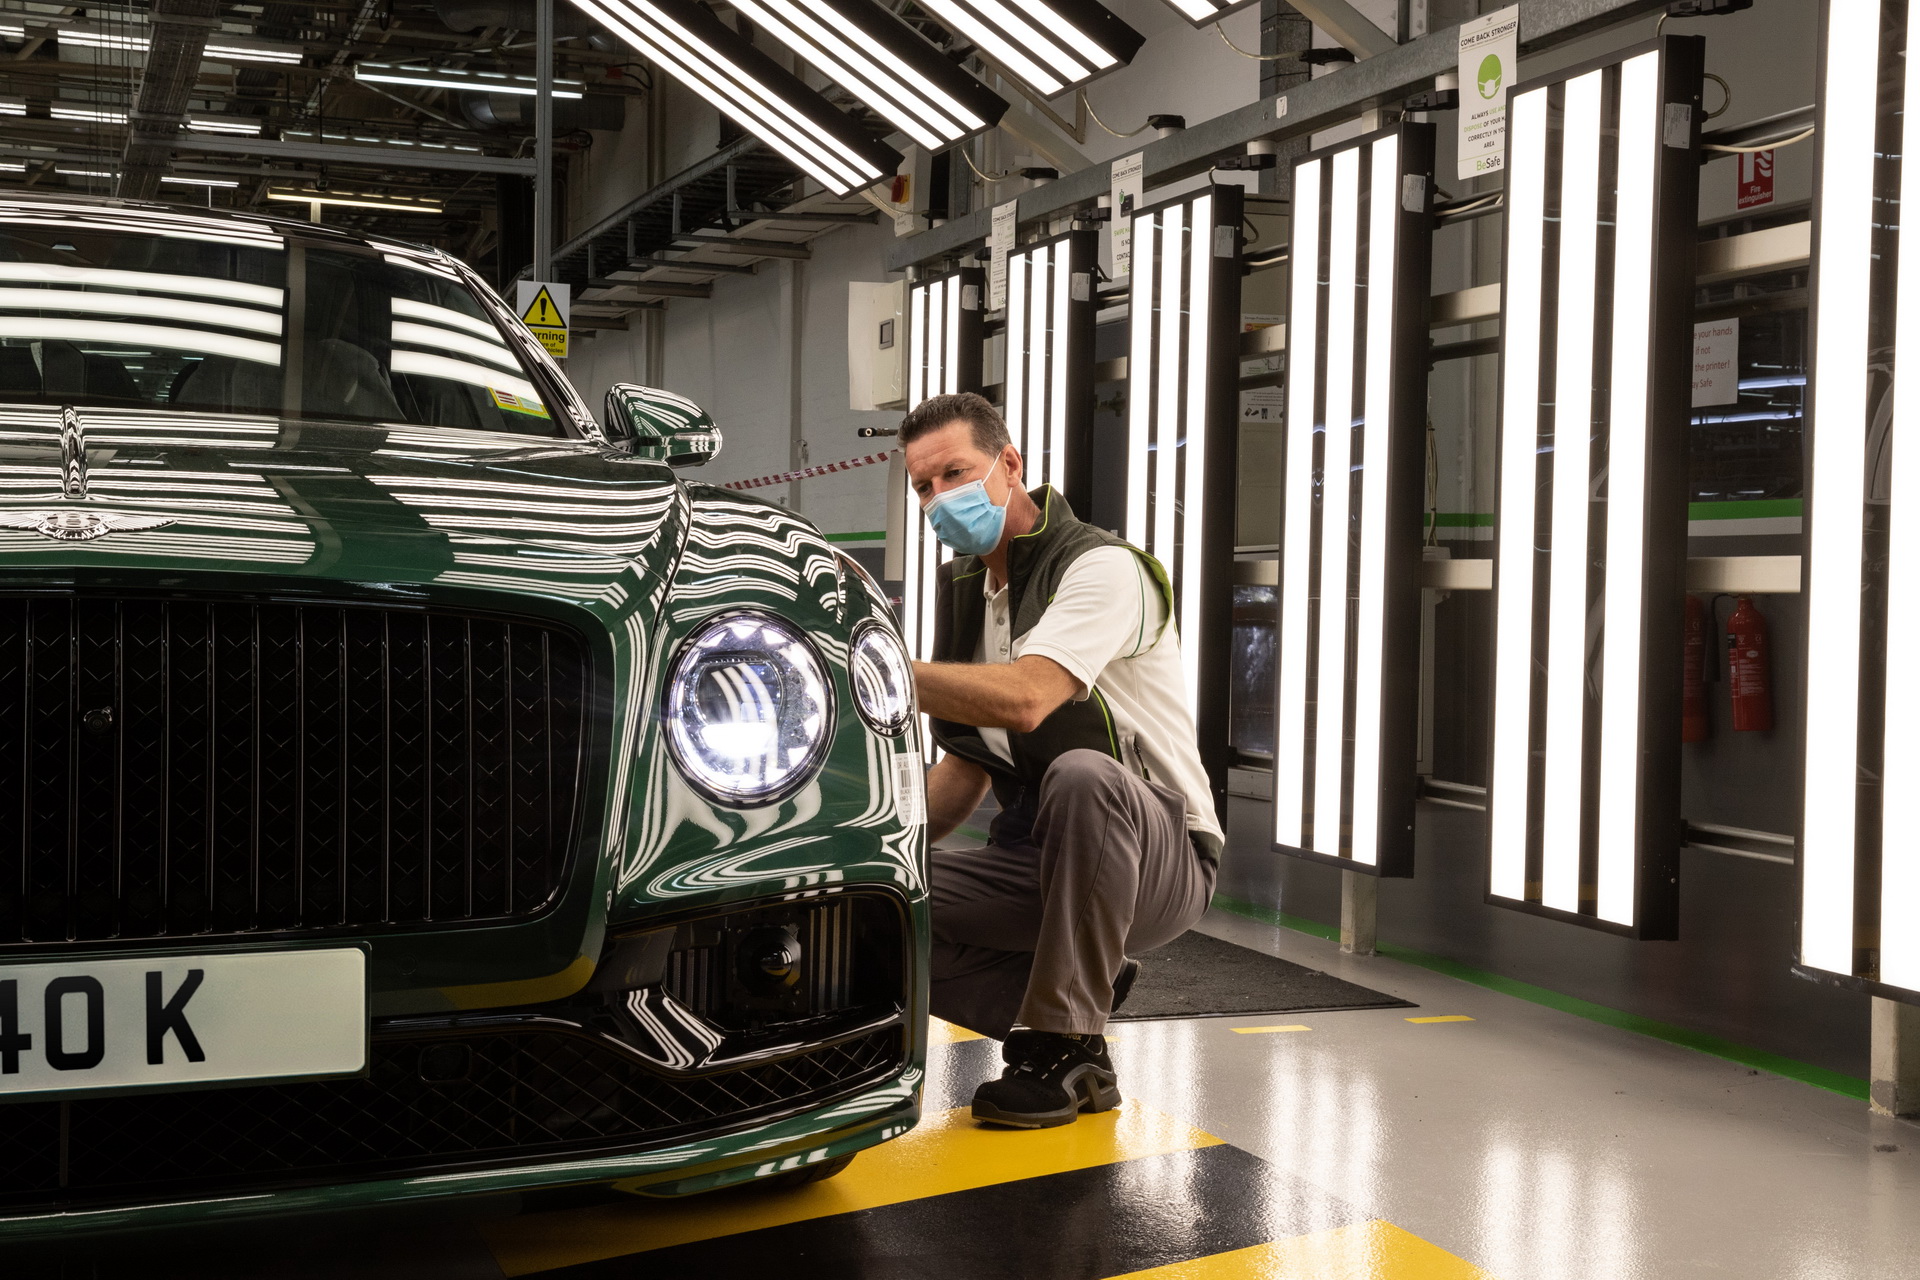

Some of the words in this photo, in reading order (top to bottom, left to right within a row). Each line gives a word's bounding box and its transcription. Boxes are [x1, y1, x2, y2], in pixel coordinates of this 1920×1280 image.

[1461, 36, 1475, 46] COME
[1476, 31, 1490, 41] BACK
[1492, 21, 1516, 36] STRONGER
[1471, 110, 1488, 120] ALWAYS
[1464, 124, 1482, 132] DISPOSE
[1468, 131, 1492, 142] CORRECTLY
[1476, 156, 1500, 171] BeSafe
[1751, 186, 1760, 194] Fire
[1739, 191, 1772, 204] extinguisher
[1698, 330, 1711, 340] your
[1712, 327, 1732, 336] hands
[1696, 346, 1699, 355] if
[1695, 364, 1704, 372] the
[1706, 360, 1730, 372] printer!
[1700, 378, 1712, 388] Safe
[146, 969, 206, 1065] K
